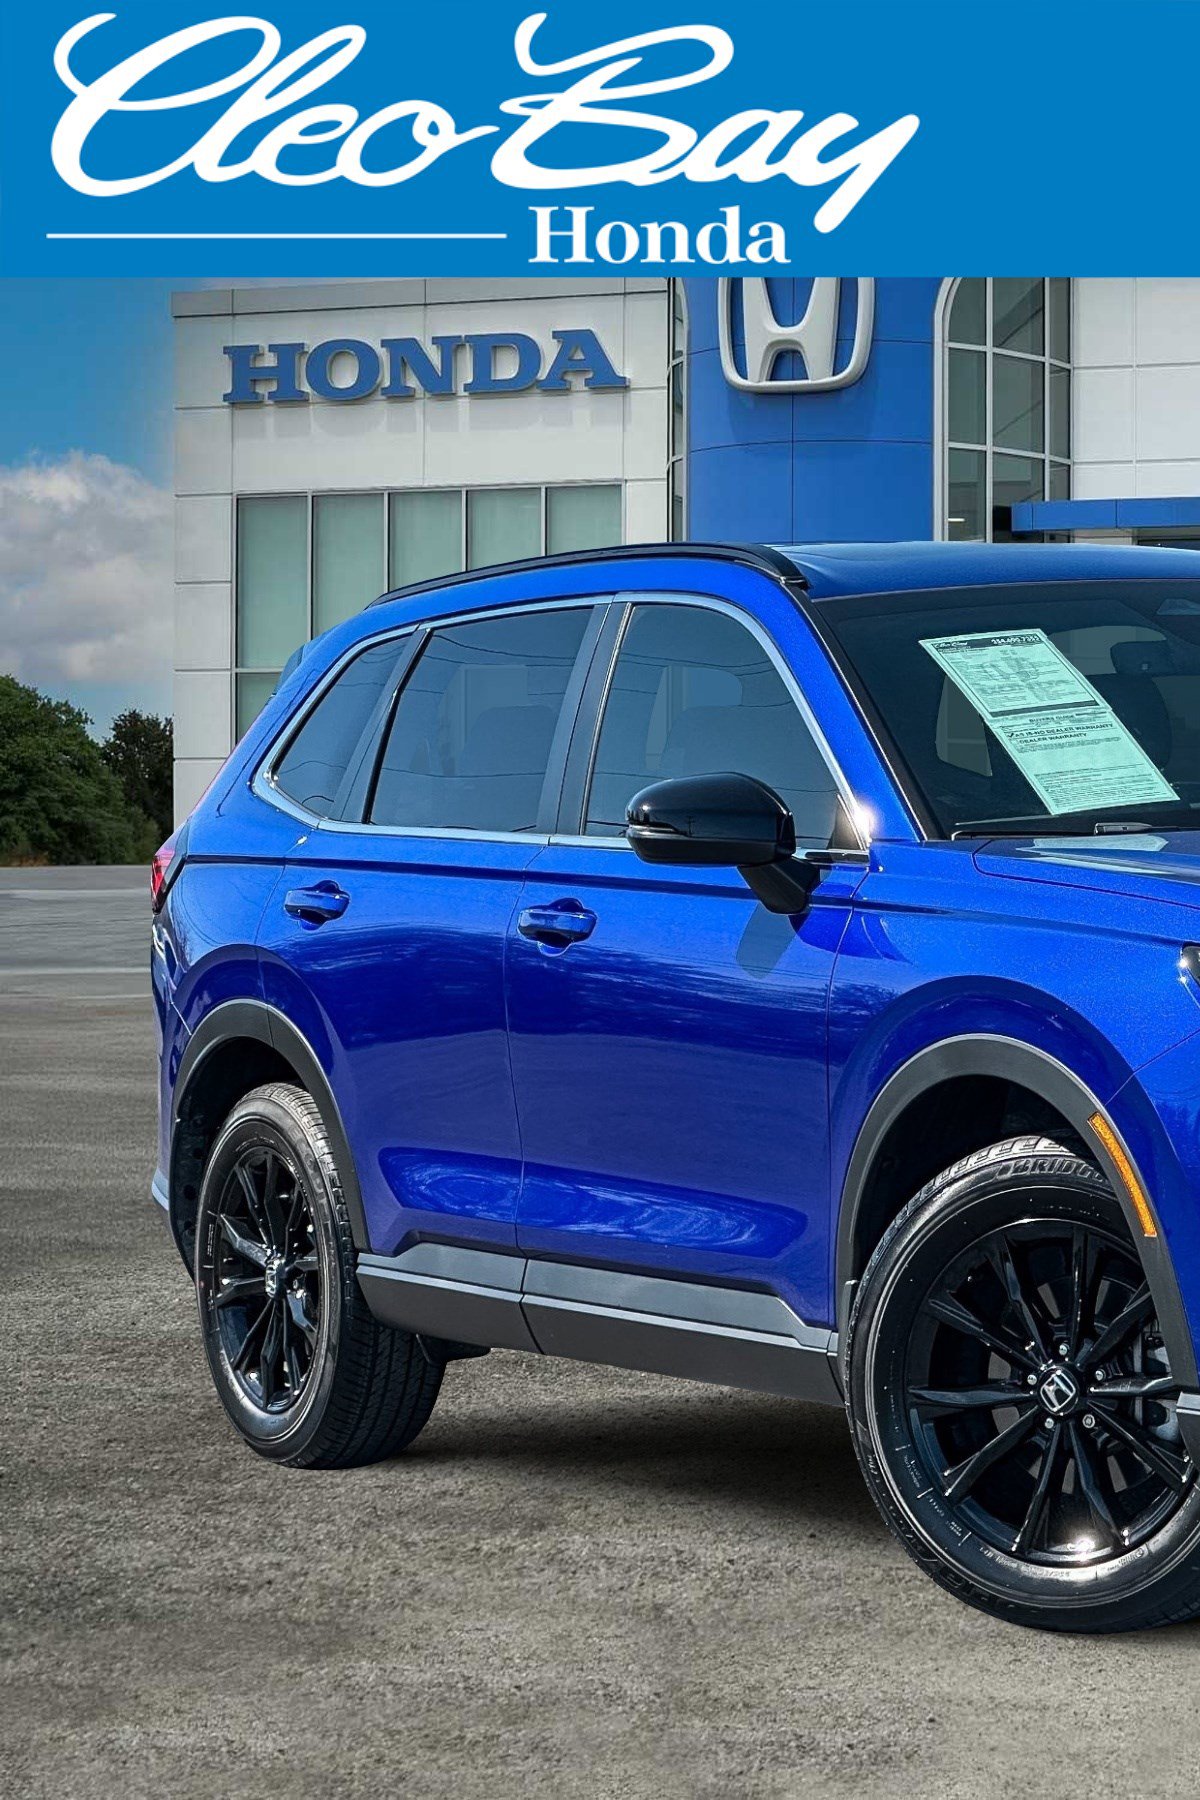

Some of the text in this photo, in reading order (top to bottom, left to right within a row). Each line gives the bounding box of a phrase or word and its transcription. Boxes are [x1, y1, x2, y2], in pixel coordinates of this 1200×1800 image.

[223, 329, 629, 403] HONDA
[1046, 726, 1075, 735] DEALER
[1075, 723, 1114, 731] WARRANTY
[1019, 732, 1087, 744] DEALER WARRANTY
